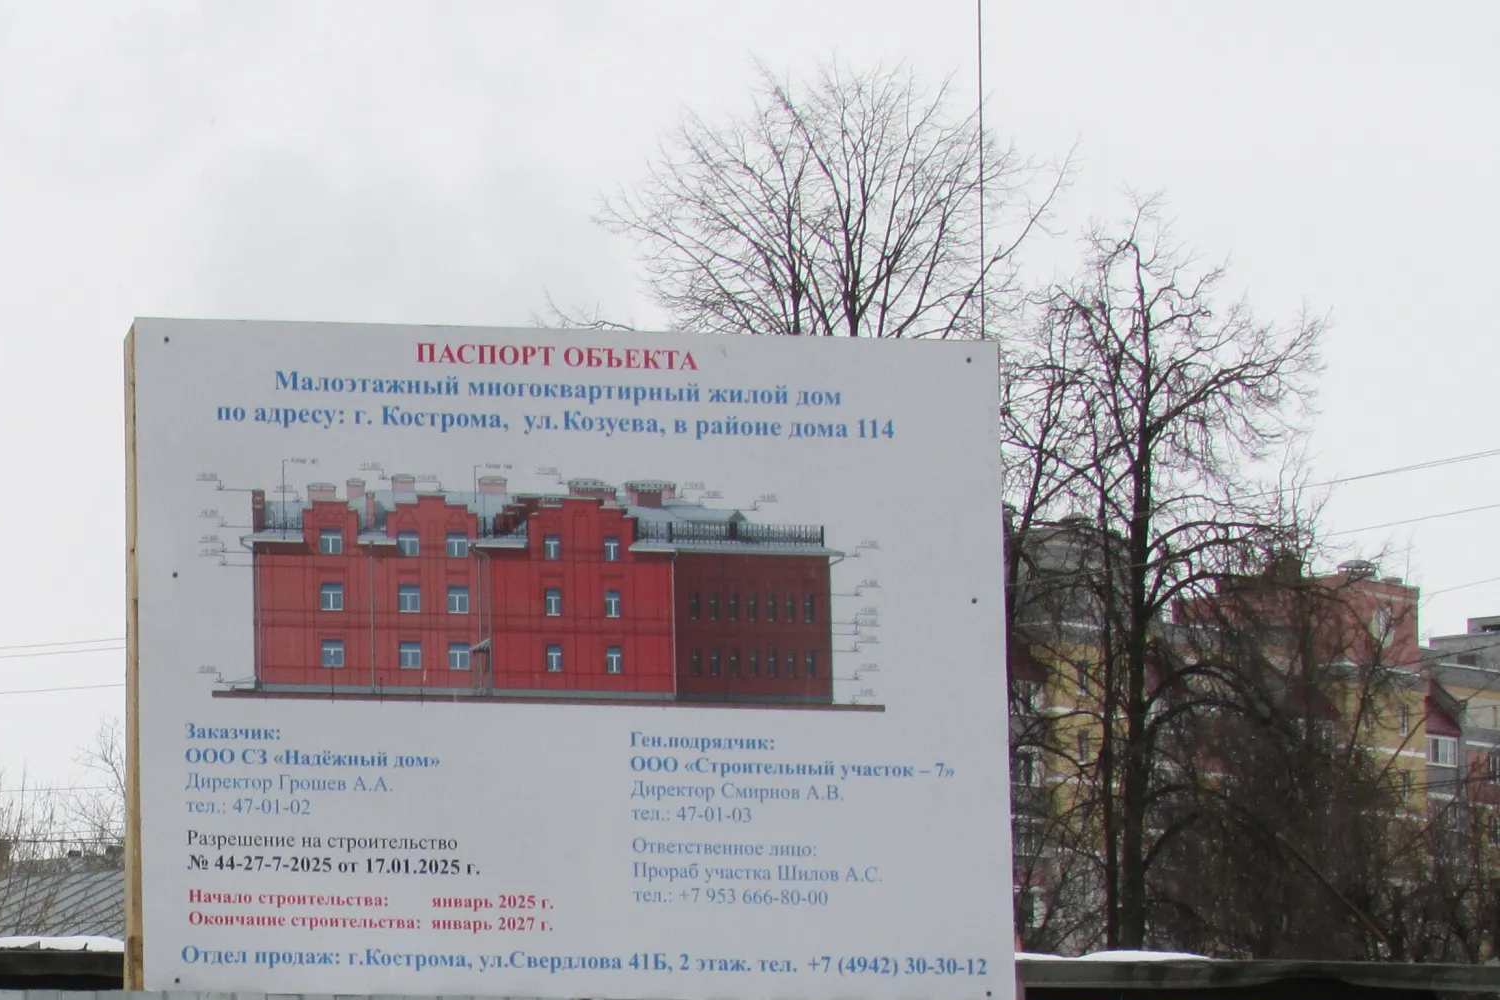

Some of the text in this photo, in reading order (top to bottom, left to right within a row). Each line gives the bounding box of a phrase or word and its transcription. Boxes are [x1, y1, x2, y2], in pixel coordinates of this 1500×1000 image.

[417, 343, 698, 370] ПАСПОРТ ОБЪЕКТА
[276, 370, 841, 407] Малоэтажный многоквартирный жилой дом
[217, 406, 245, 421] по
[254, 408, 344, 428] адресу:
[355, 410, 372, 425] г.
[382, 405, 509, 433] Кострома,
[675, 420, 687, 434] в
[696, 416, 781, 440] районе
[788, 423, 848, 439] дома
[858, 418, 895, 438] 114
[185, 723, 280, 740] Заказчик:
[185, 748, 440, 768] ООО СЗ «Надёжный дом»
[630, 756, 678, 772] ООО
[685, 758, 835, 778] «Строительный
[841, 765, 914, 780] участок
[935, 762, 955, 777] 7»
[185, 773, 393, 794] Директор Грошев А.А.
[631, 781, 843, 803] Директор Смирнов А.В.
[186, 798, 310, 815] тел.: 47-01-02
[631, 806, 751, 822] тел.: 47-01-03
[188, 830, 457, 853] Разрешение на строительство
[632, 838, 817, 858] Ответственное лицо:
[187, 854, 480, 875] № 44-27-7-2025 от 17.01.2025 г.
[634, 862, 882, 883] Прораб участка Шилов А.С.
[189, 889, 553, 912] Начало строительства: январь 2025 г.
[633, 888, 828, 905] тел.: +7 953 666-80-00
[188, 911, 552, 934] Окончание строительства: январь 2027 г.
[182, 946, 247, 965] Отдел
[255, 951, 340, 969] продаж:
[628, 953, 672, 972] 41Б,
[679, 953, 689, 971] 2
[696, 959, 751, 972] этаж.
[760, 960, 797, 973] тел.
[808, 956, 832, 972] +7
[838, 957, 899, 977] (4942)
[905, 957, 988, 975] 30-30-12
